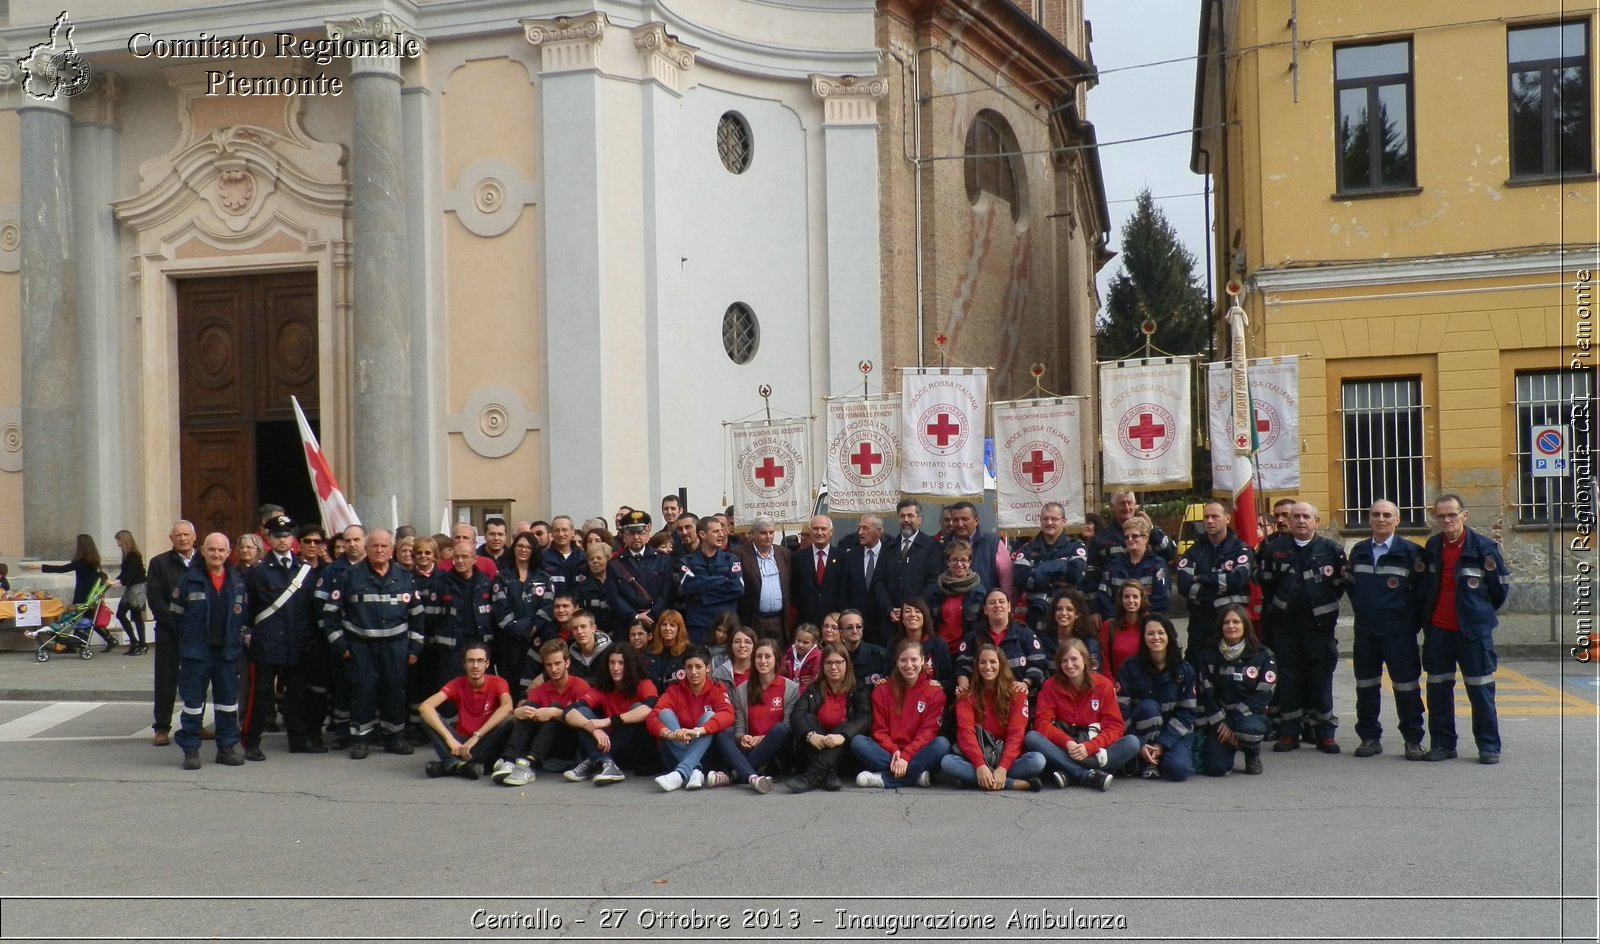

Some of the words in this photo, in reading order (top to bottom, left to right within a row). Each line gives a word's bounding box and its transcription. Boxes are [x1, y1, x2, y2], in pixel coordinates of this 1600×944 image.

[1233, 336, 1245, 365] CUNEO
[909, 387, 929, 409] CROCE
[928, 380, 954, 389] ROSSA
[955, 383, 979, 411] ITALIANA
[1213, 390, 1231, 412] CROC
[1264, 381, 1295, 407] ITALIANA
[1235, 392, 1247, 428] COMITATO
[829, 428, 847, 455] CROCE
[847, 420, 874, 431] ROSSA
[1004, 431, 1022, 449] CROCE
[1023, 425, 1045, 433] ROSSA
[1046, 426, 1070, 446] ITALIANA
[737, 445, 752, 469] CROCE
[753, 437, 777, 448] ROSSA
[780, 440, 803, 466] ITALIANA
[947, 461, 975, 469] LOCALE
[1128, 467, 1168, 476] CENTALLO
[922, 481, 961, 489] BUSCA
[745, 500, 789, 509] DELEGAZIONE
[830, 498, 855, 506] BORGO
[866, 497, 900, 505] DALMAZZ
[1010, 501, 1043, 509] COMITATO
